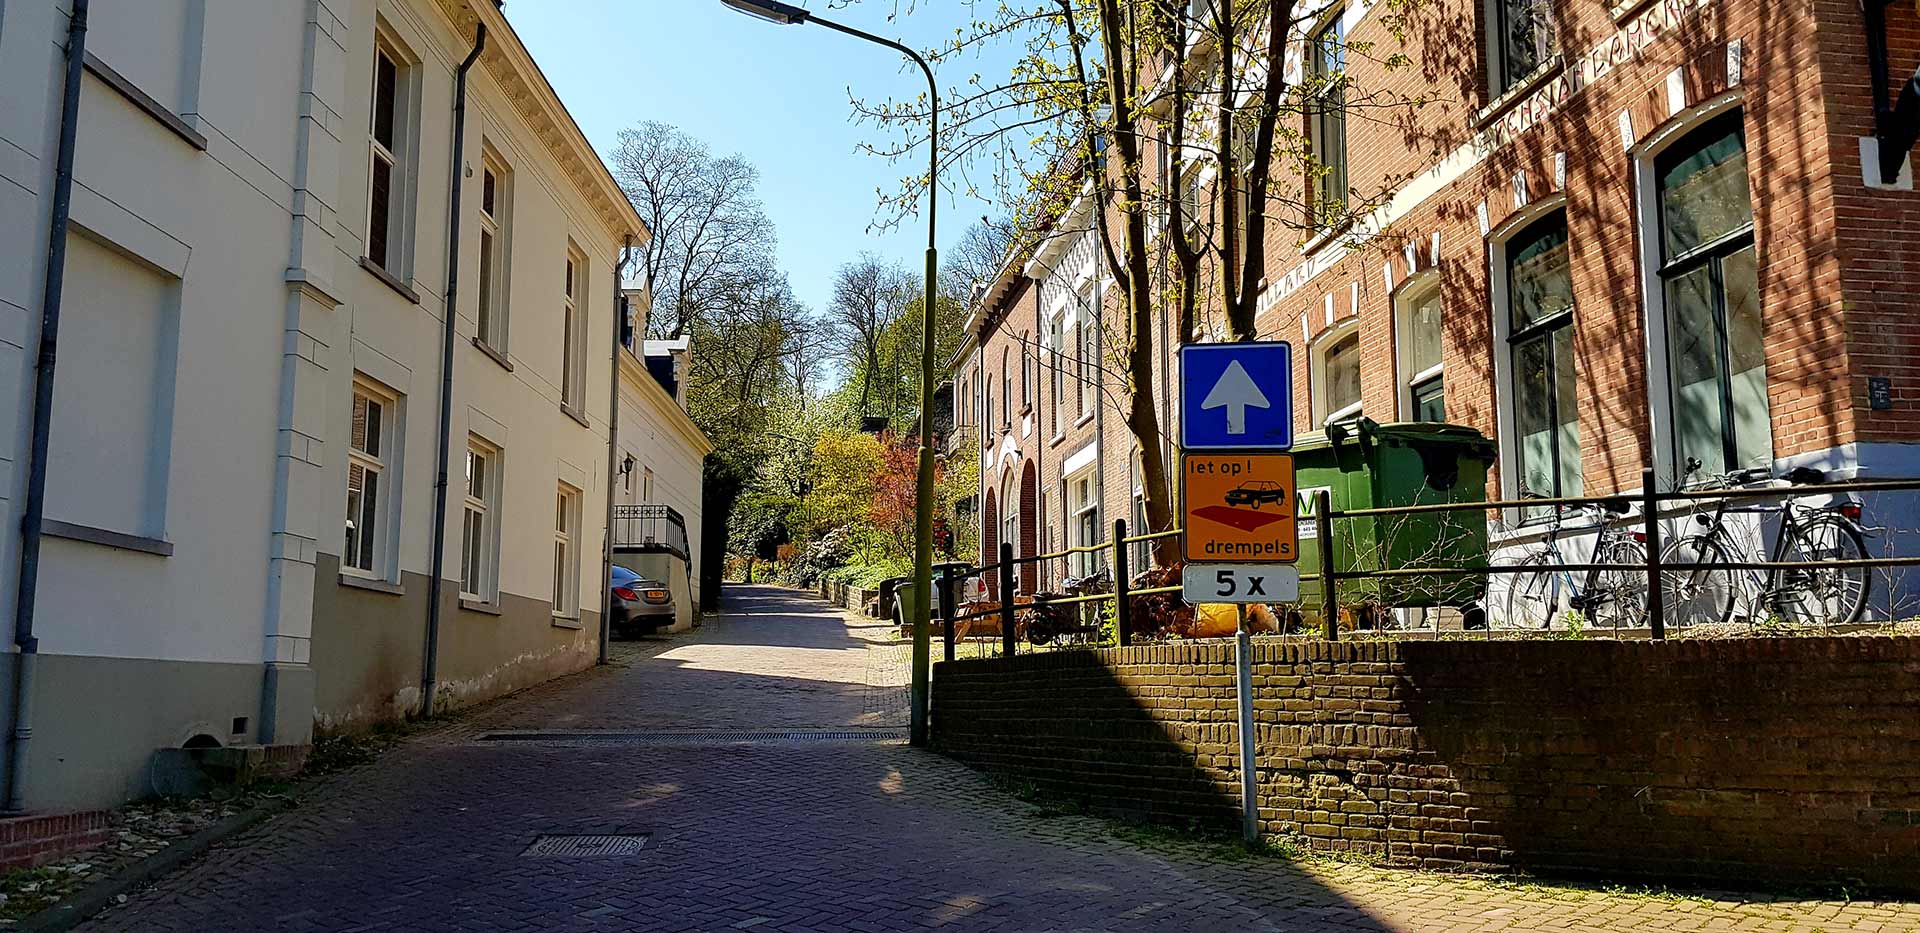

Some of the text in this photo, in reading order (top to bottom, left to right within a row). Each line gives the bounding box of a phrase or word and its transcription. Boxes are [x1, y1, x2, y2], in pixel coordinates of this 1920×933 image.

[1256, 257, 1316, 313] ILLARD
[1190, 460, 1214, 474] let
[1220, 463, 1241, 476] op
[1204, 539, 1290, 556] drempels
[1216, 571, 1266, 597] 5 x
